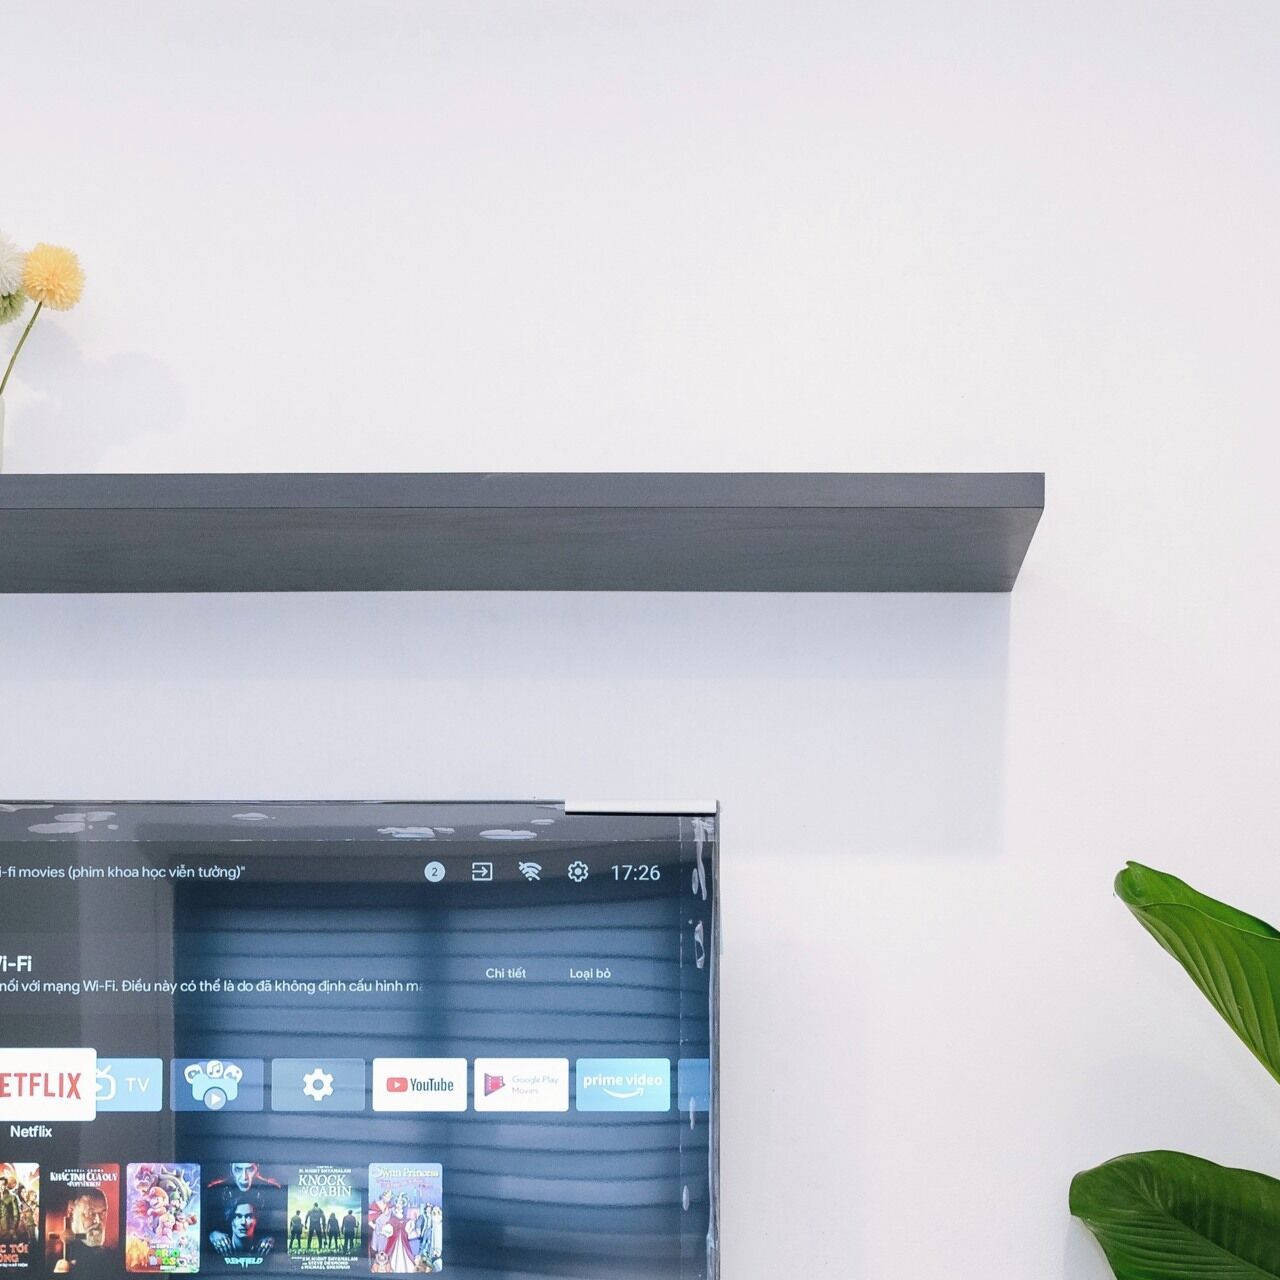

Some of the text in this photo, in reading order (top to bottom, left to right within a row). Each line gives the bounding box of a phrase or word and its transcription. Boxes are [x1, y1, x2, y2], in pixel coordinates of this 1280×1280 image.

[18, 866, 66, 879] movies
[68, 865, 105, 881] (phim
[107, 865, 140, 879] khoa
[142, 865, 167, 880] học
[168, 863, 195, 879] viễn
[611, 864, 661, 881] 17:26
[485, 966, 527, 979] Chi tiết
[569, 967, 612, 981] Loại bỏ
[0, 978, 19, 993] nối
[21, 979, 41, 993] với
[43, 981, 81, 995] mạng
[82, 979, 119, 993] Wi-Fi.
[121, 978, 151, 993] Điều
[154, 979, 178, 995] này
[180, 979, 197, 993] có
[199, 978, 221, 993] thể
[223, 979, 235, 993] là
[237, 980, 254, 993] do
[256, 979, 273, 993] đã
[274, 979, 316, 995] không
[318, 979, 347, 995] định
[349, 978, 373, 993] cấu
[125, 1077, 151, 1092] TV
[409, 1076, 455, 1092] YouTube
[511, 1074, 560, 1085] Google Play
[583, 1073, 663, 1088] prime video
[10, 1124, 53, 1138] Netflix
[298, 1174, 347, 1186] KNOCK
[310, 1185, 352, 1197] CABIN
